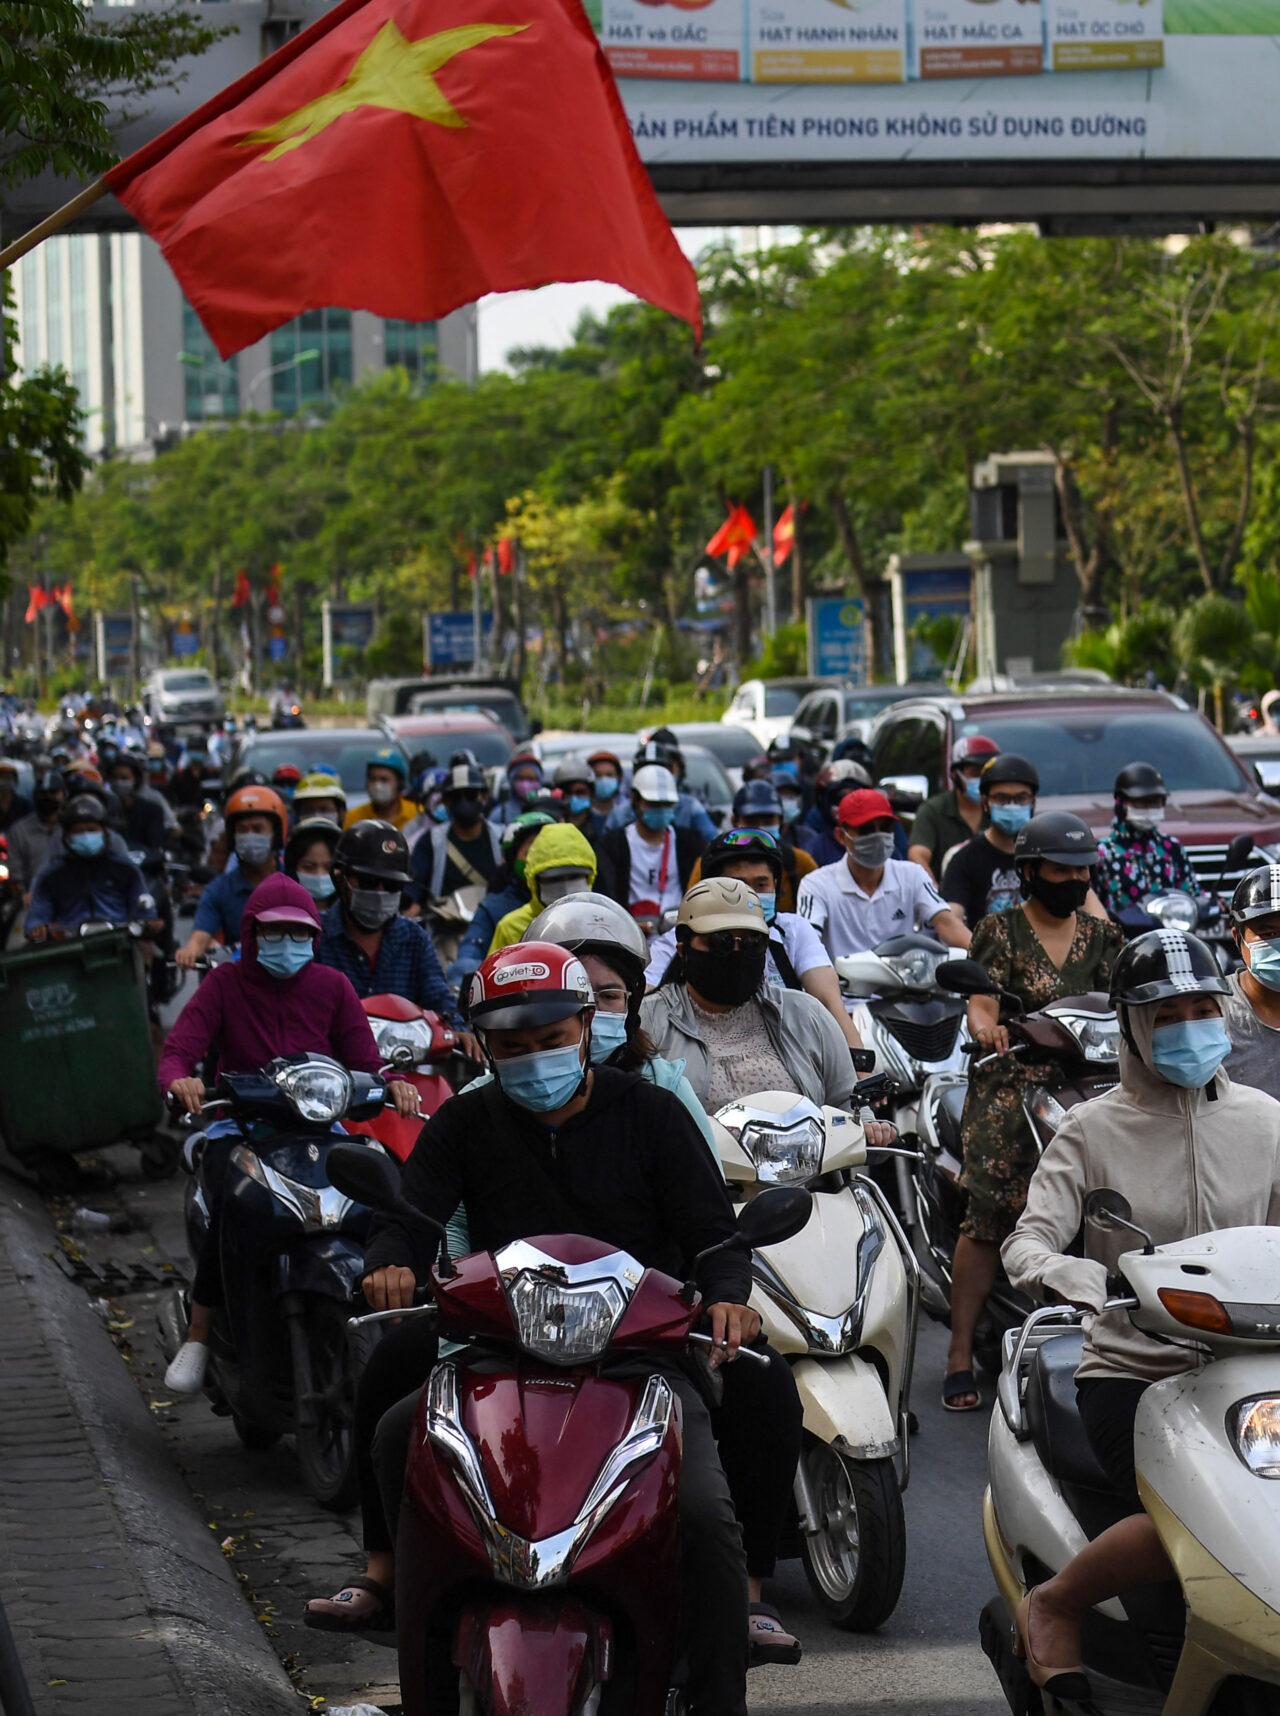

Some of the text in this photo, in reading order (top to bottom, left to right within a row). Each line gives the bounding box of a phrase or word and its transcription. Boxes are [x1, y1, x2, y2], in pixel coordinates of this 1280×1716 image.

[1001, 24, 1023, 39] CA
[628, 113, 666, 138] ẢN
[745, 113, 795, 138] TIÊN
[802, 117, 879, 138] PHONG
[885, 112, 962, 137] KHÔNG
[1003, 116, 1064, 140] DỤNG
[1071, 113, 1146, 138] ĐƯỜNG
